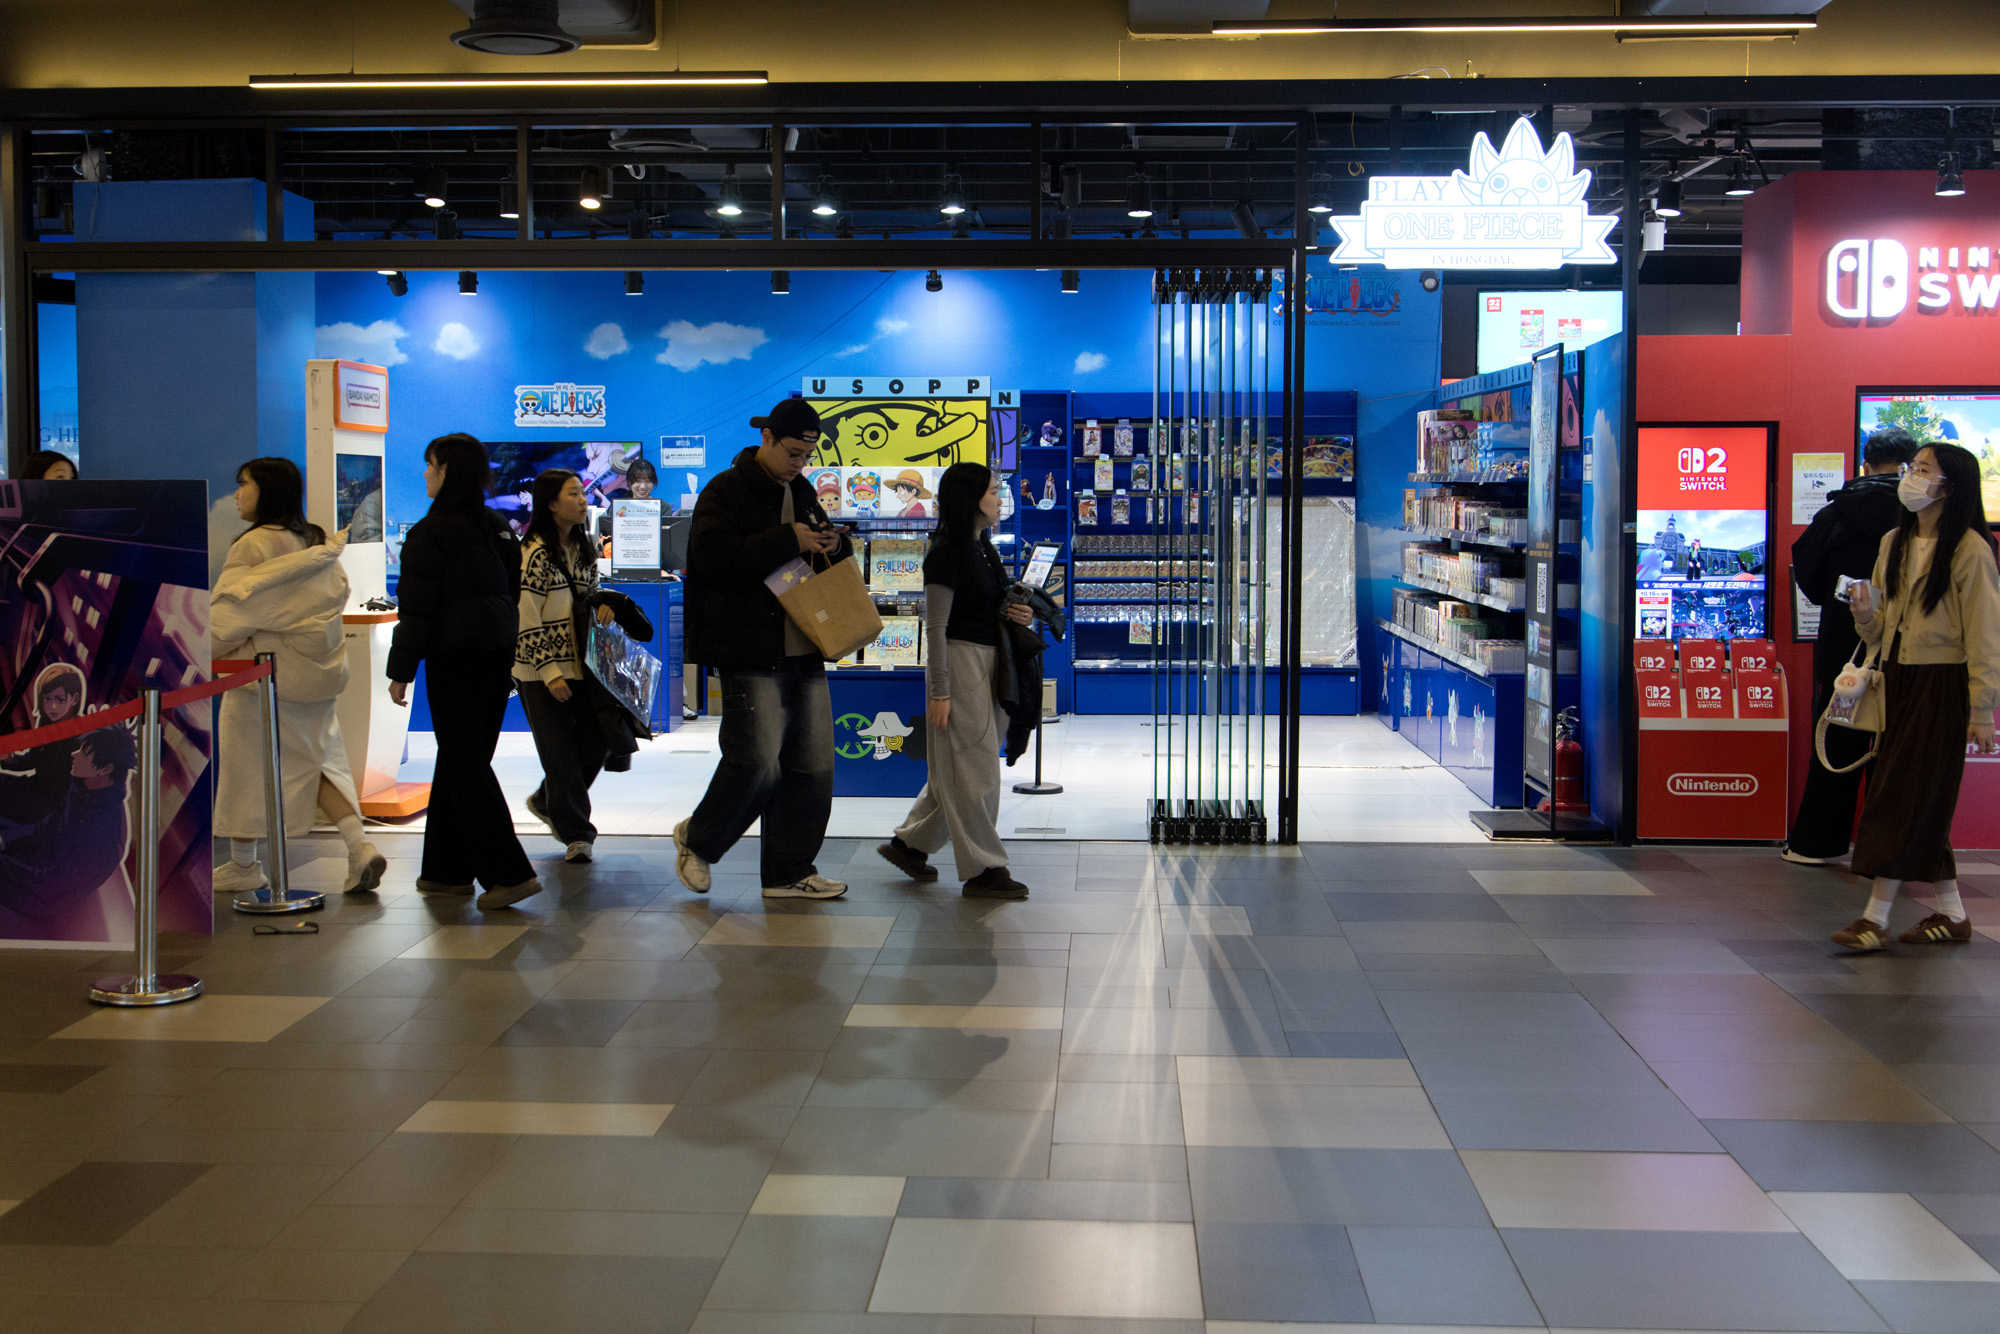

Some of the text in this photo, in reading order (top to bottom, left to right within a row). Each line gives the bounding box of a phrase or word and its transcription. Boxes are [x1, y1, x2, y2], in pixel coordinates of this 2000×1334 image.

[1373, 180, 1450, 201] PLAY
[1383, 212, 1564, 240] ONE PIECE
[1432, 255, 1515, 265] IN HONGDAE
[1919, 247, 2000, 268] NIN
[1337, 278, 1401, 310] PIECE
[812, 379, 980, 395] USOPP
[348, 389, 379, 403] BANDAI NAMCO
[519, 390, 603, 413] ONE PIECE
[1706, 447, 1728, 473] 2
[1679, 482, 1725, 490] SWITCH
[1337, 499, 1355, 515] 2000
[877, 560, 919, 571] ONE PIECE
[891, 636, 913, 647] PIECE
[1660, 686, 1671, 699] 2
[1710, 686, 1722, 699] 2
[1762, 686, 1773, 699] 2
[1675, 778, 1750, 791] Nintendo
